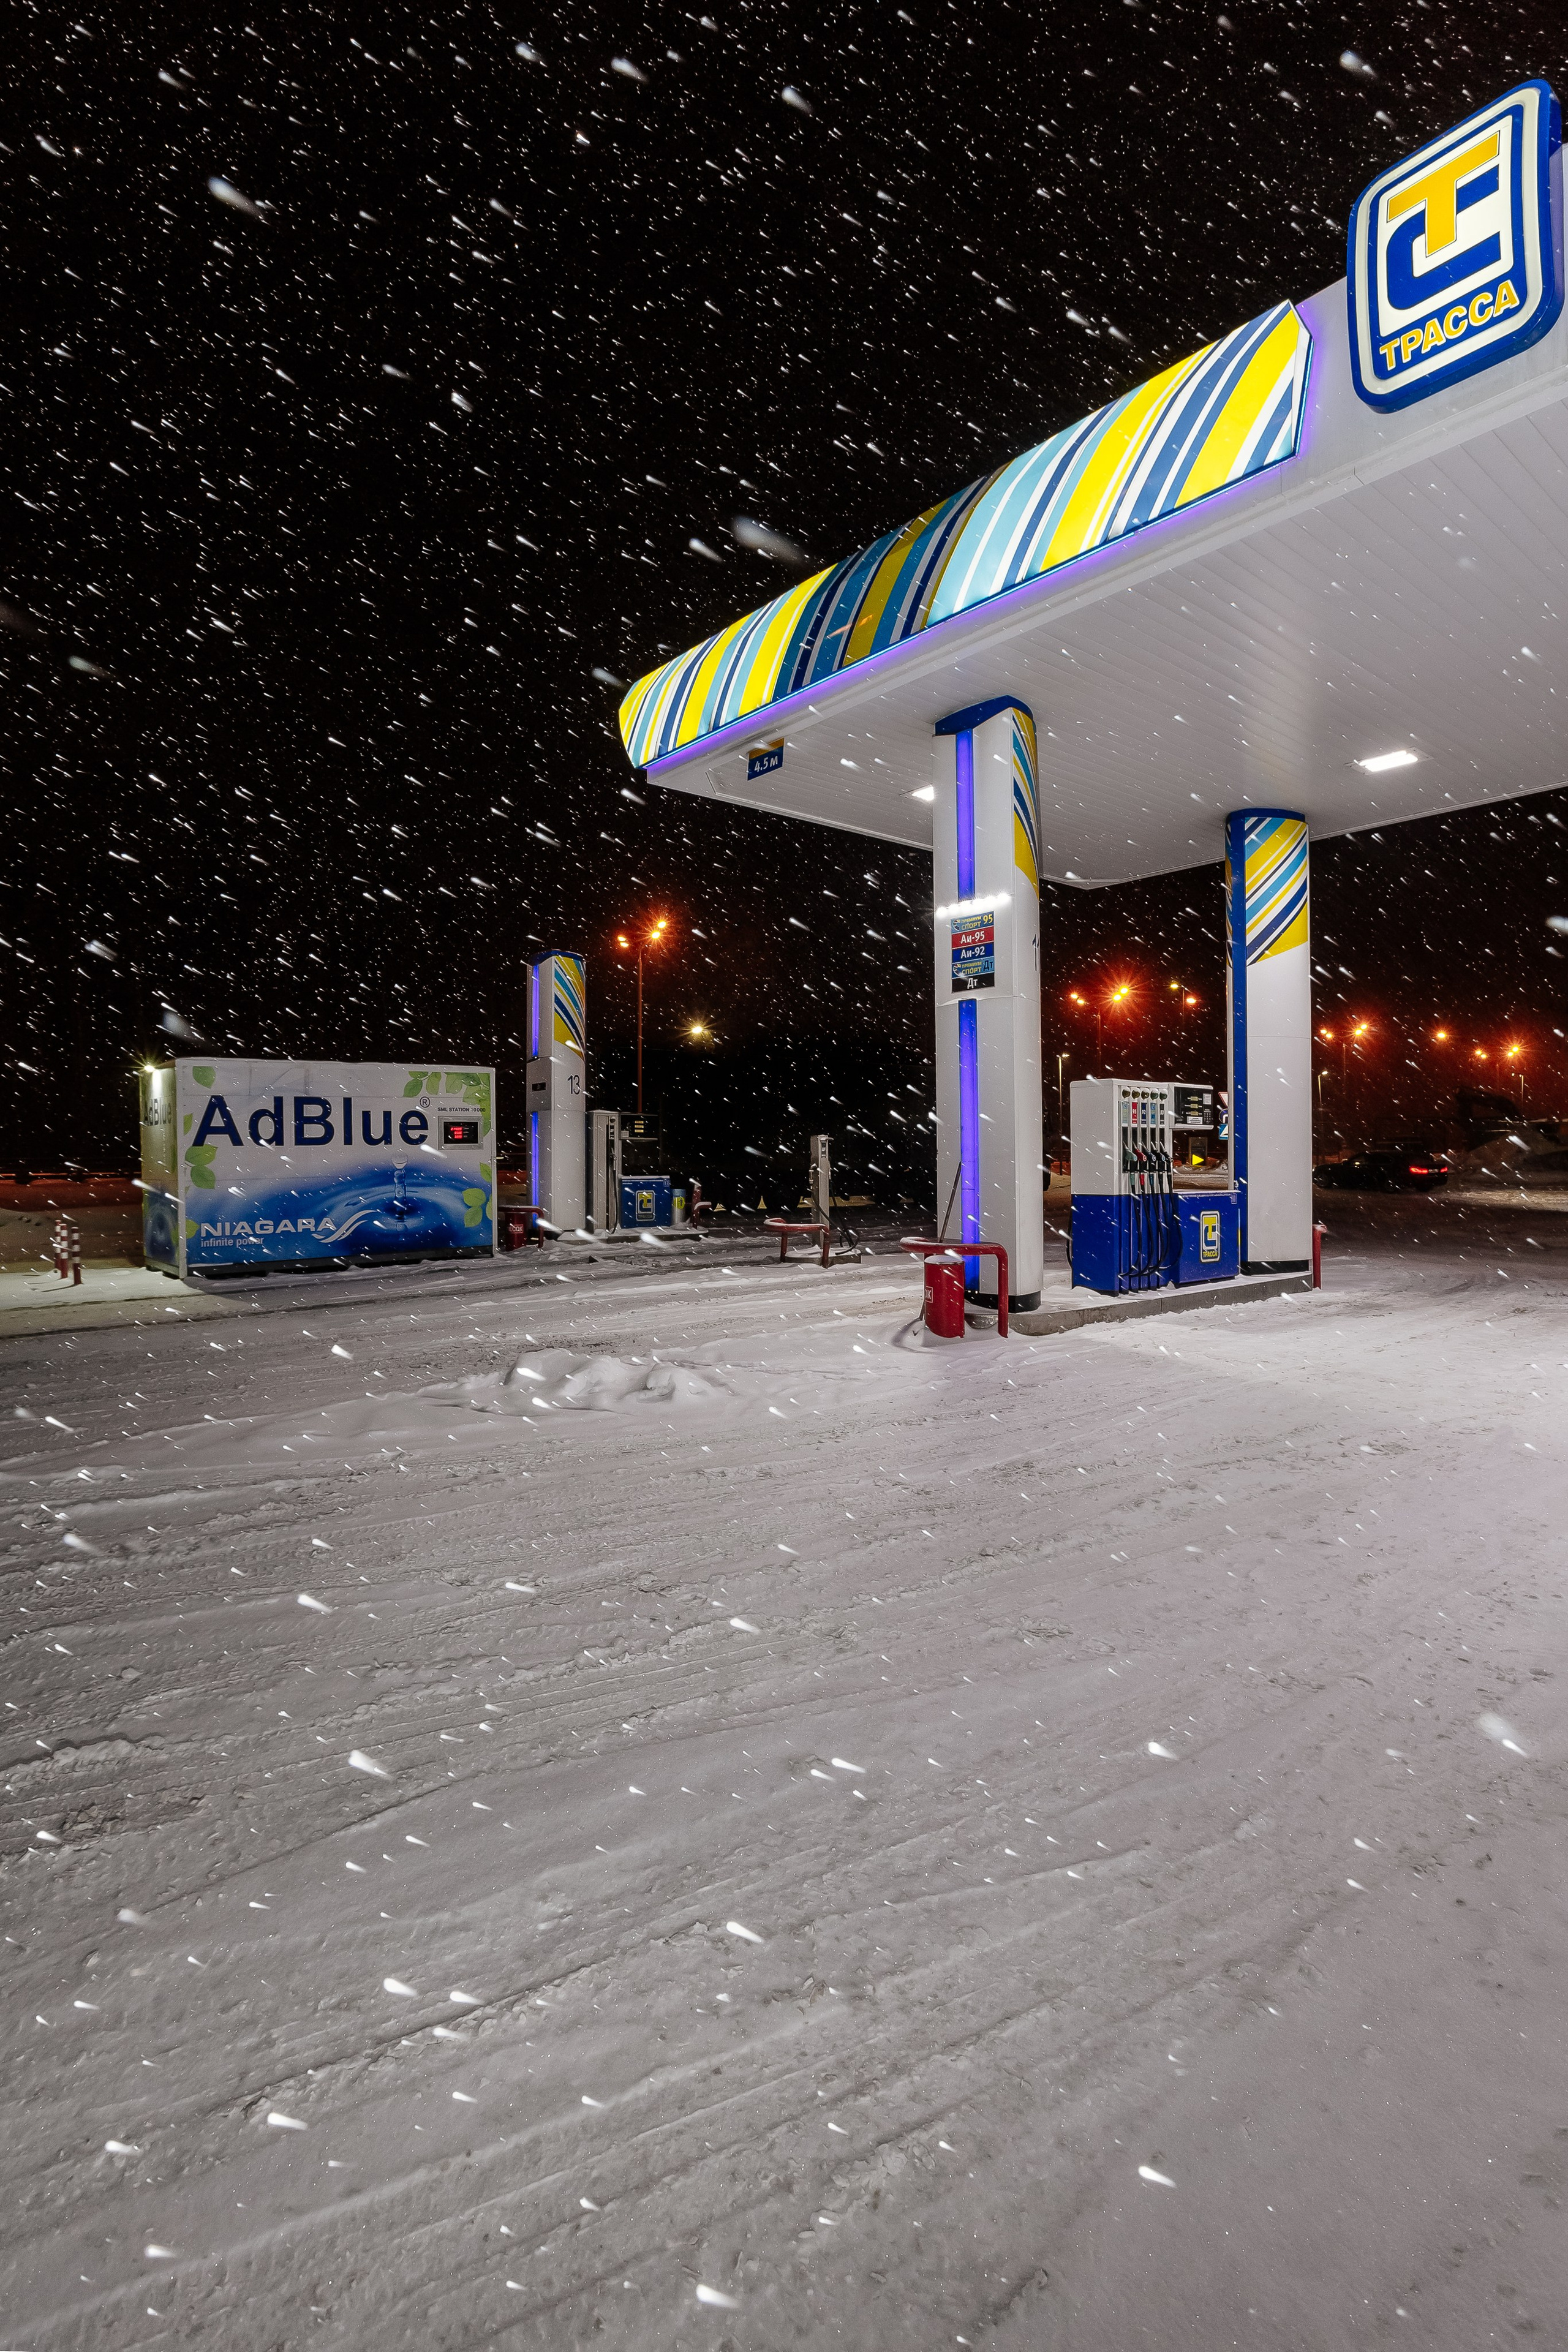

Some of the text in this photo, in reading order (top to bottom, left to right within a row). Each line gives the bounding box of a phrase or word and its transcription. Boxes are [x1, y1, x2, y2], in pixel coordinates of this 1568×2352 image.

[1379, 279, 1520, 371] ТРАССА
[754, 756, 769, 772] 4.5
[961, 921, 981, 930] СПОРТ
[983, 914, 993, 925] 95
[960, 930, 985, 944] Аи-95
[960, 946, 986, 959] Аи-92
[962, 967, 982, 975] СПОРТ
[567, 1074, 581, 1095] 13
[200, 1217, 337, 1237] NIAGARA
[200, 1236, 264, 1247] infinite power
